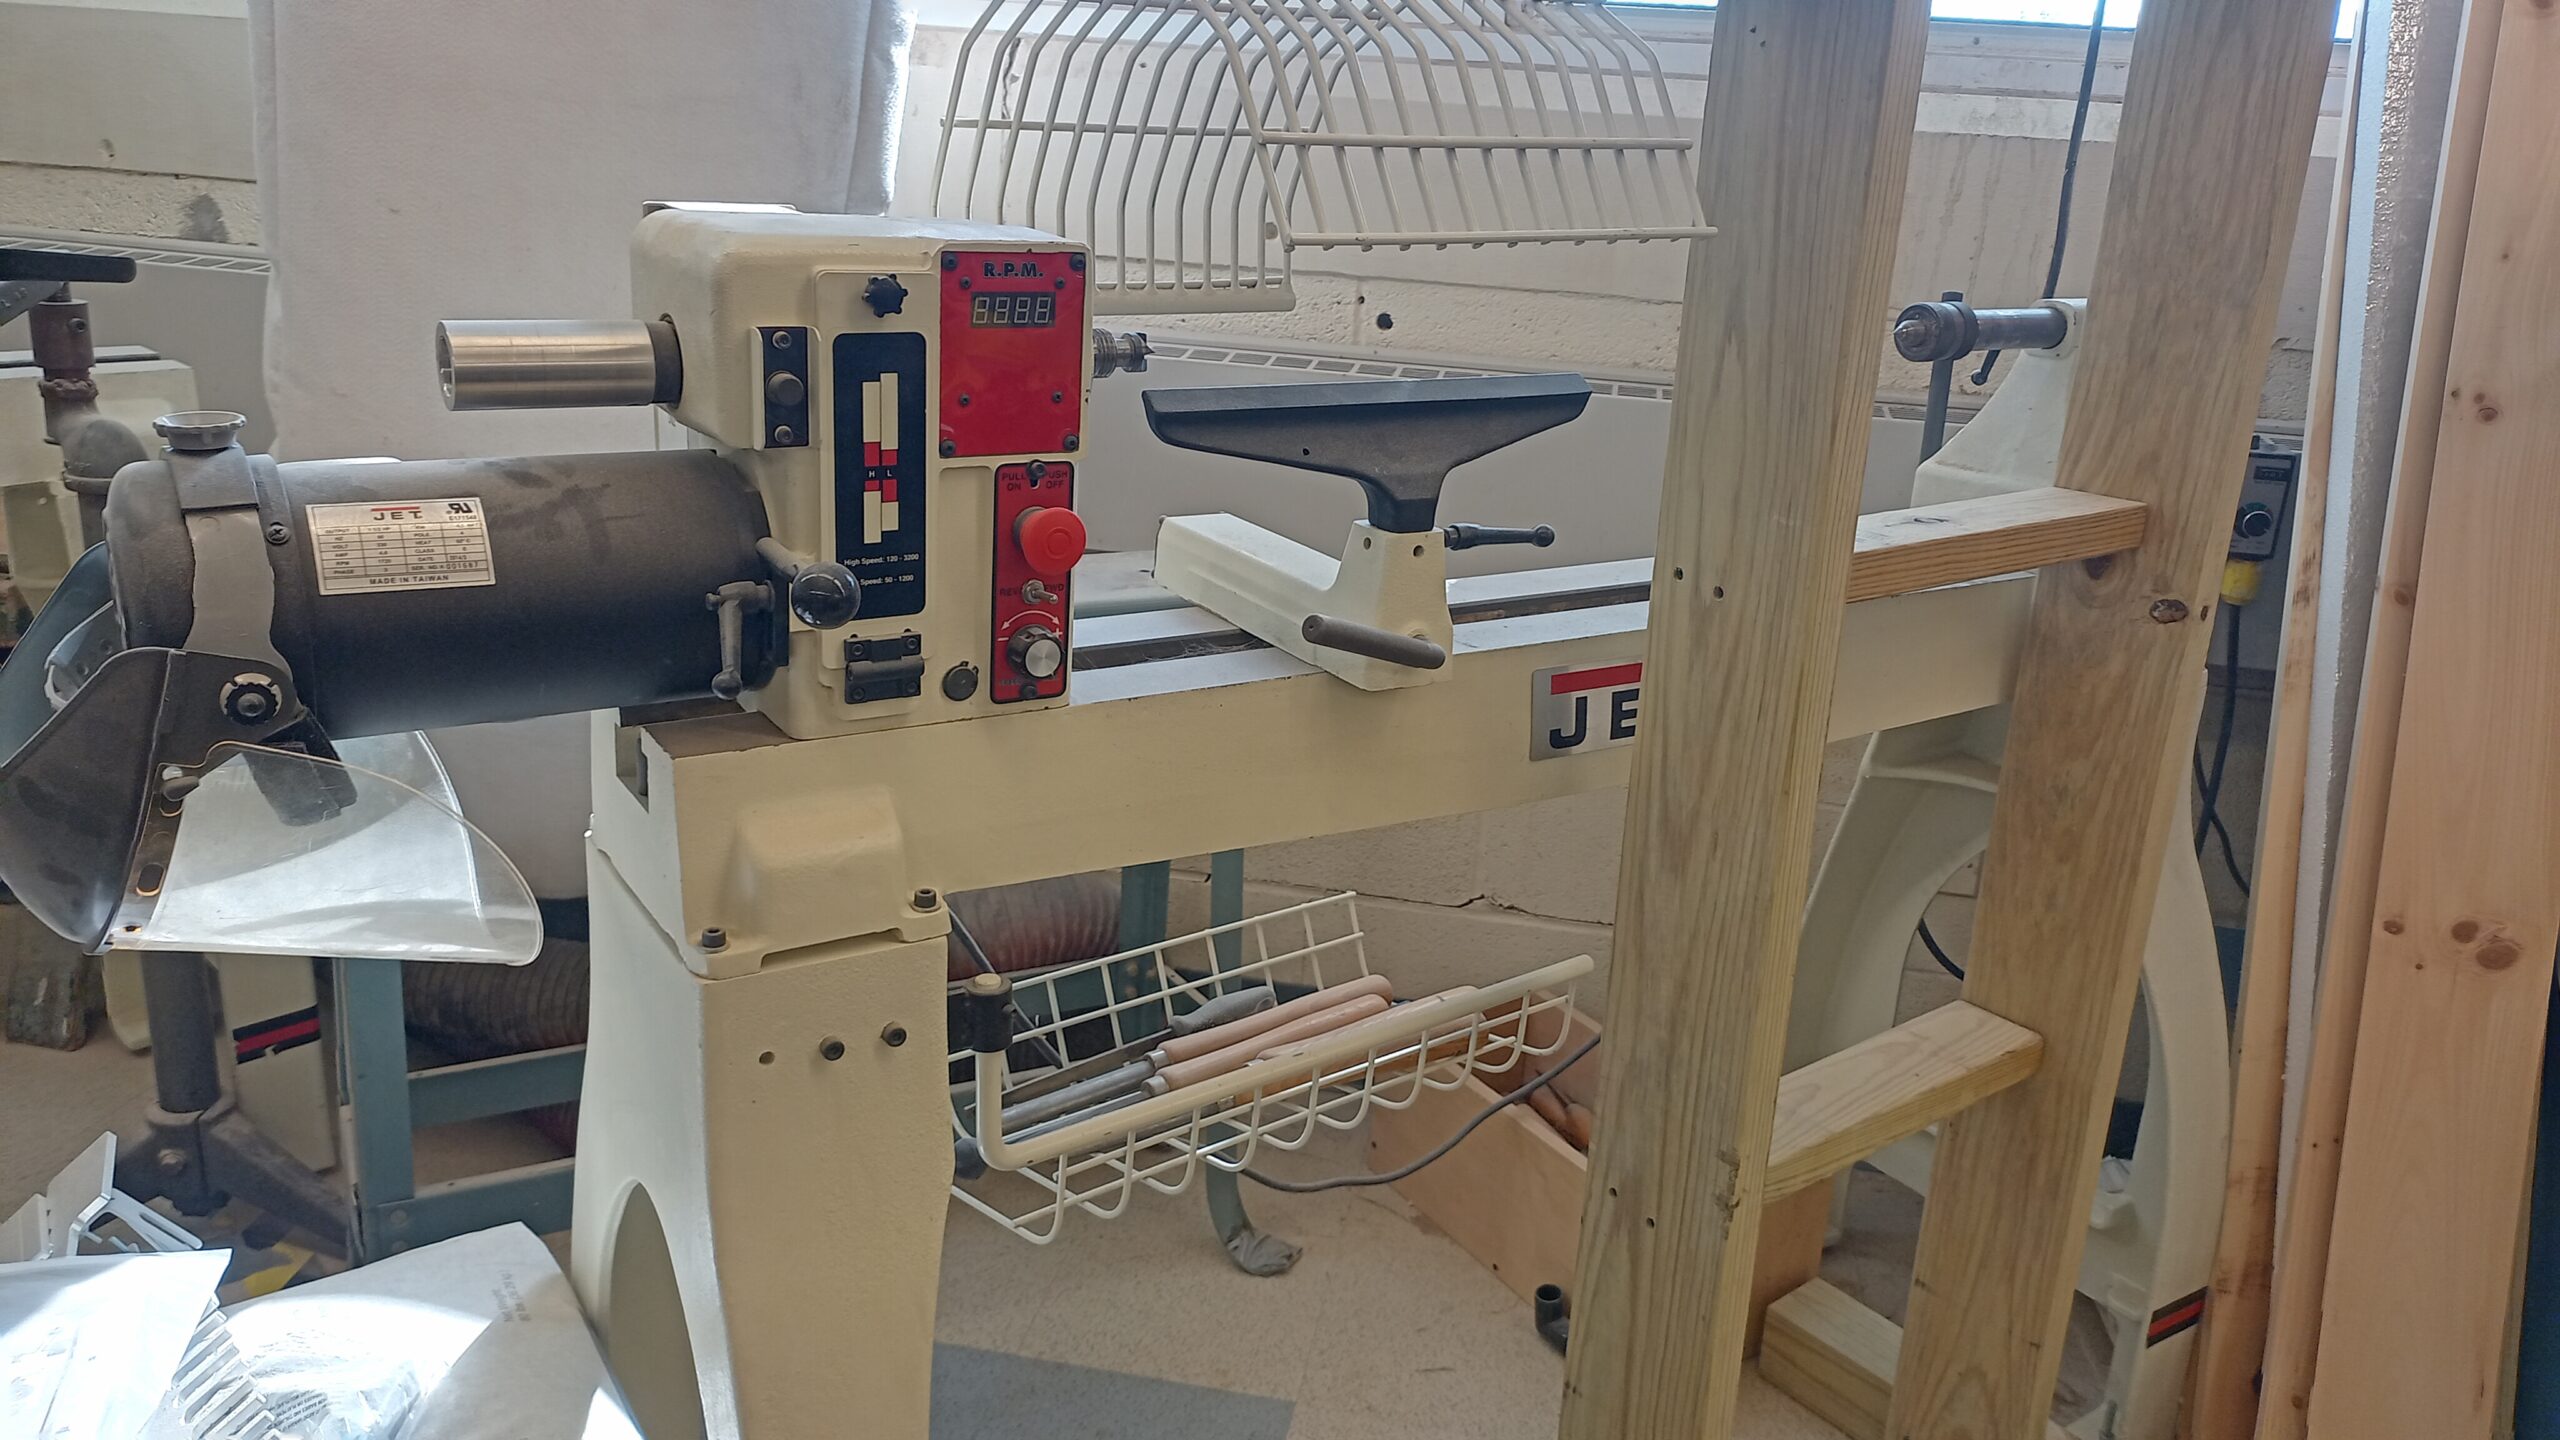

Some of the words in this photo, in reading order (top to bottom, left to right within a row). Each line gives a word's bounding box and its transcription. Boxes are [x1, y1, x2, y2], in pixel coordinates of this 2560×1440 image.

[984, 262, 1044, 277] R.P.M.
[868, 470, 875, 478] H
[887, 469, 892, 477] L
[1002, 472, 1026, 480] PULL
[1048, 471, 1068, 479] USH
[1007, 483, 1021, 491] ON
[1046, 480, 1064, 488] OFF
[374, 511, 422, 520] JET
[844, 559, 860, 567] High
[861, 557, 885, 565] Speed:
[860, 577, 884, 586] Speed:
[1549, 688, 1640, 749] JE
